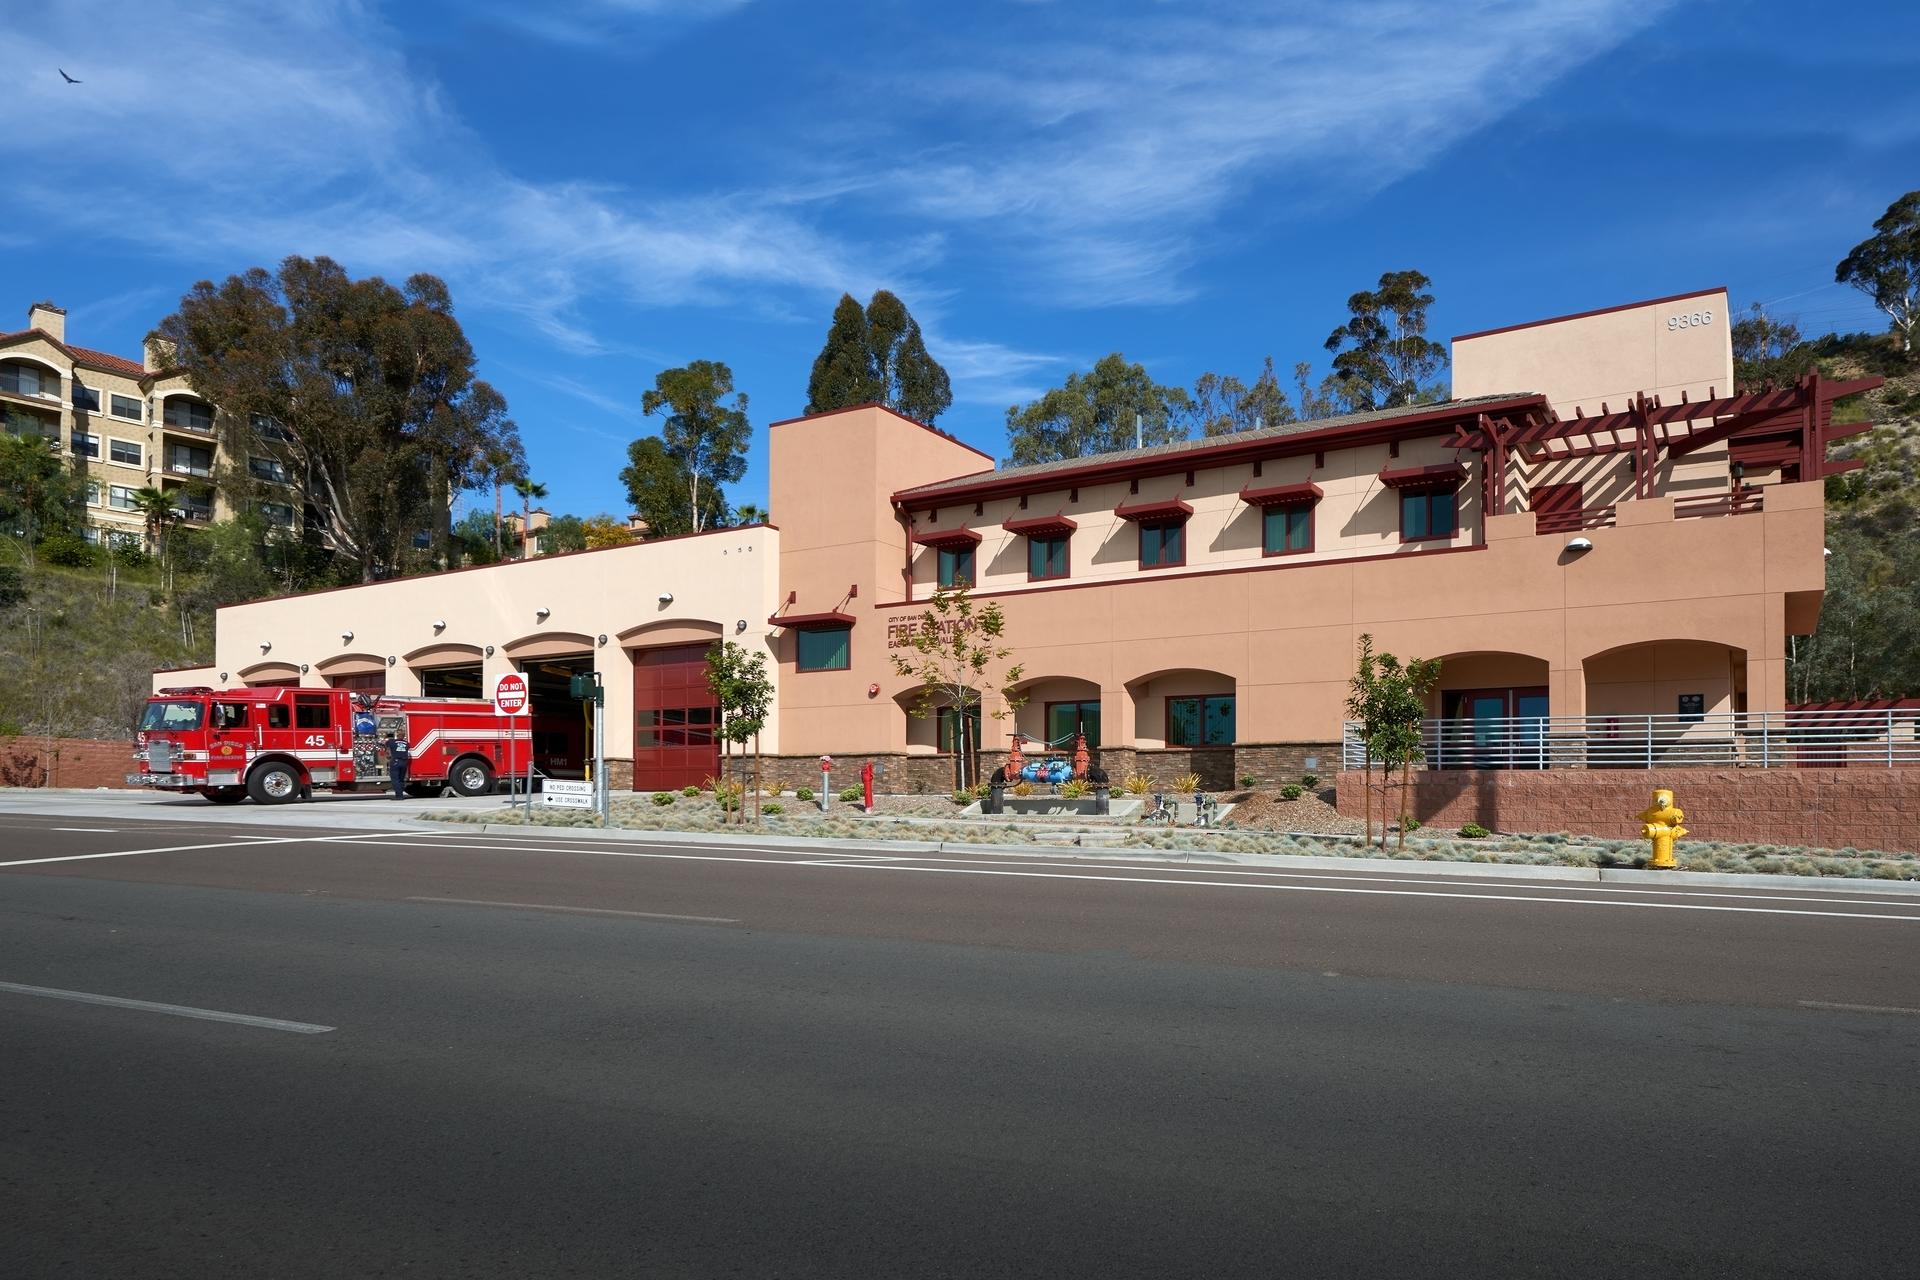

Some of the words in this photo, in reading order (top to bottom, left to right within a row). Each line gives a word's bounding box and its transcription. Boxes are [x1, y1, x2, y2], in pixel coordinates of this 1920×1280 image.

[1667, 309, 1713, 331] 9366
[888, 623, 918, 639] FIRE
[888, 640, 904, 649] EAS
[500, 683, 509, 691] DO
[510, 682, 523, 691] NOT
[501, 699, 523, 708] ENTER
[209, 741, 223, 749] SAN
[223, 740, 244, 748] DIEGO
[305, 735, 326, 747] 45
[550, 757, 568, 766] HM1
